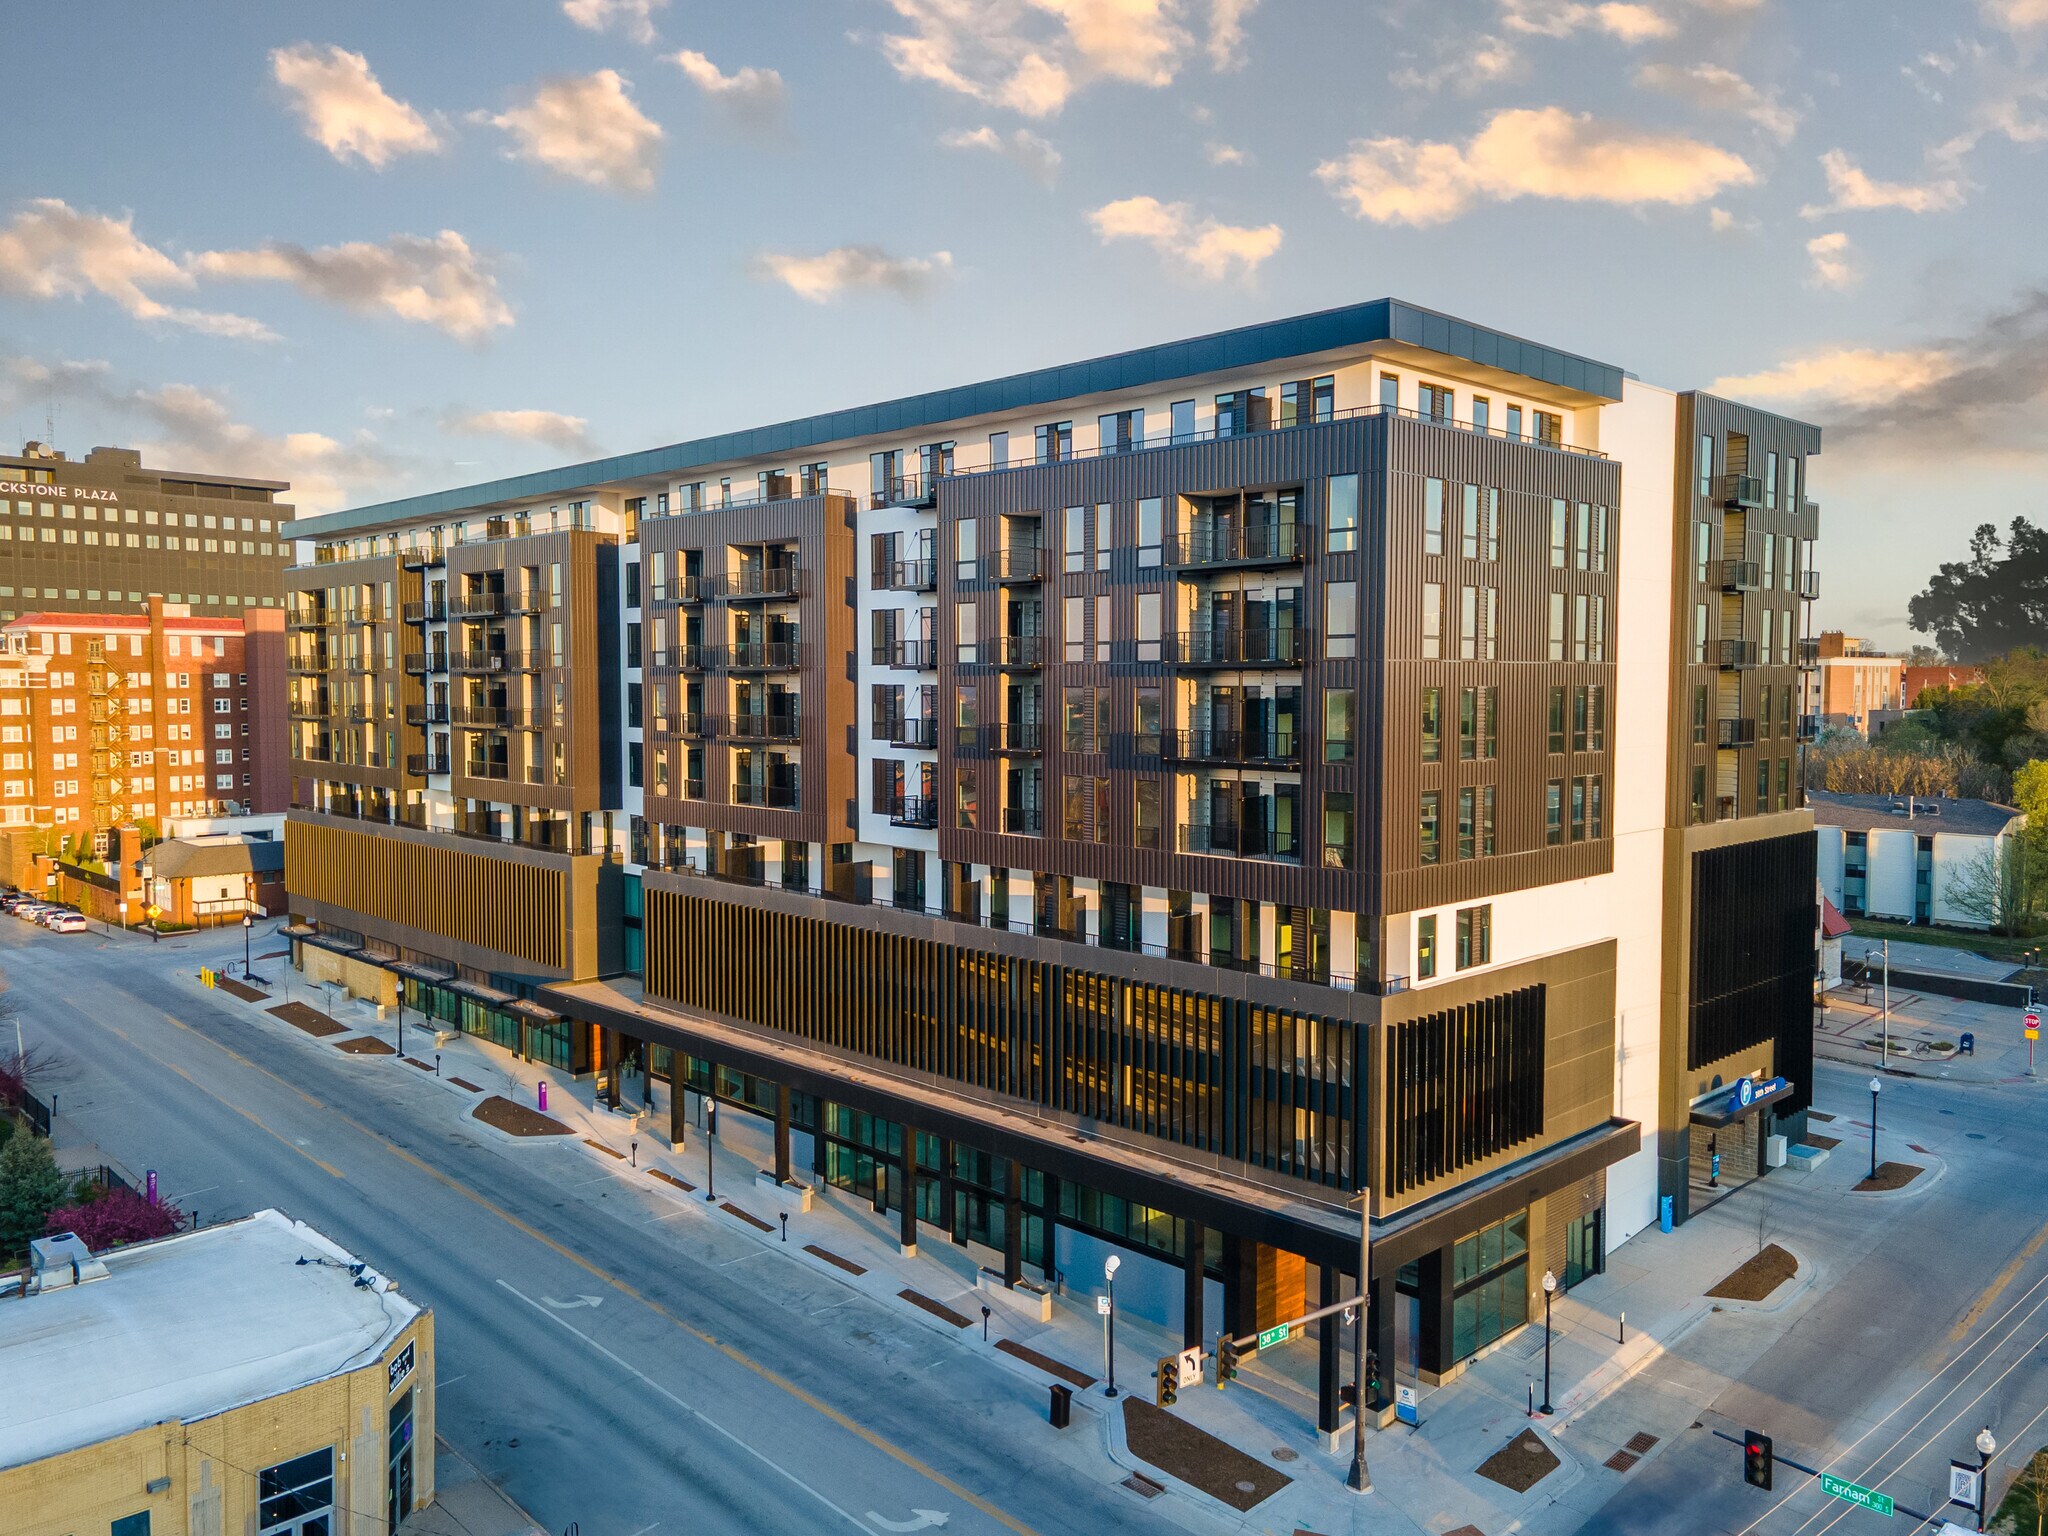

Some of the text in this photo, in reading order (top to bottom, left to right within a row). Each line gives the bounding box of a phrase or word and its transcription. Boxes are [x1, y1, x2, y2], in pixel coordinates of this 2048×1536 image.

[0, 482, 118, 501] CKSTONE PLAZA
[1764, 1082, 1776, 1095] Street
[1278, 1328, 1287, 1338] St
[390, 1356, 402, 1376] bob
[1183, 1374, 1196, 1384] ONLY
[1824, 1477, 1871, 1505] Farnam
